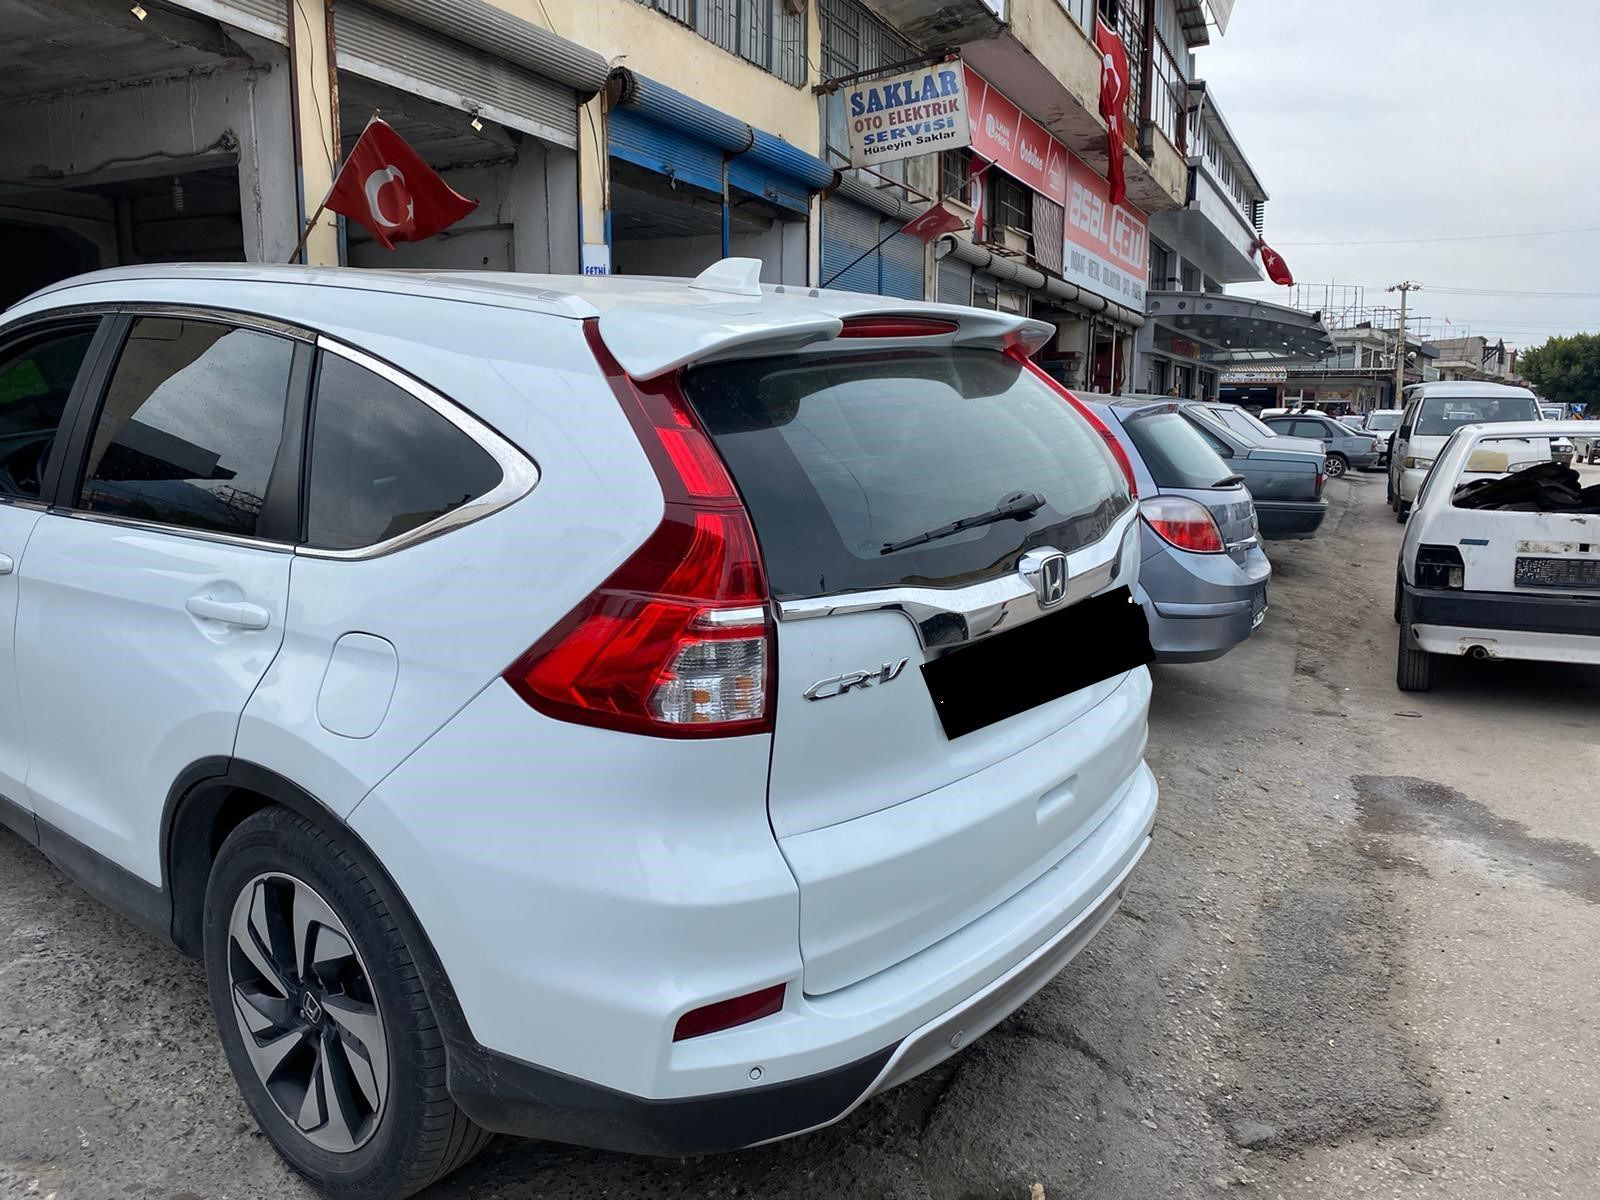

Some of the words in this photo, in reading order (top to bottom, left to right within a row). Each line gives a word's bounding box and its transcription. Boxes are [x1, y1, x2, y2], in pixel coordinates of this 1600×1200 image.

[850, 70, 959, 117] SAKLAR
[854, 115, 882, 133] OTO
[888, 98, 960, 126] ELEKTRİK
[863, 116, 954, 146] SERVİSİ
[864, 140, 912, 156] Hüseyin
[916, 131, 956, 144] Saklar
[803, 656, 910, 702] CR-V
